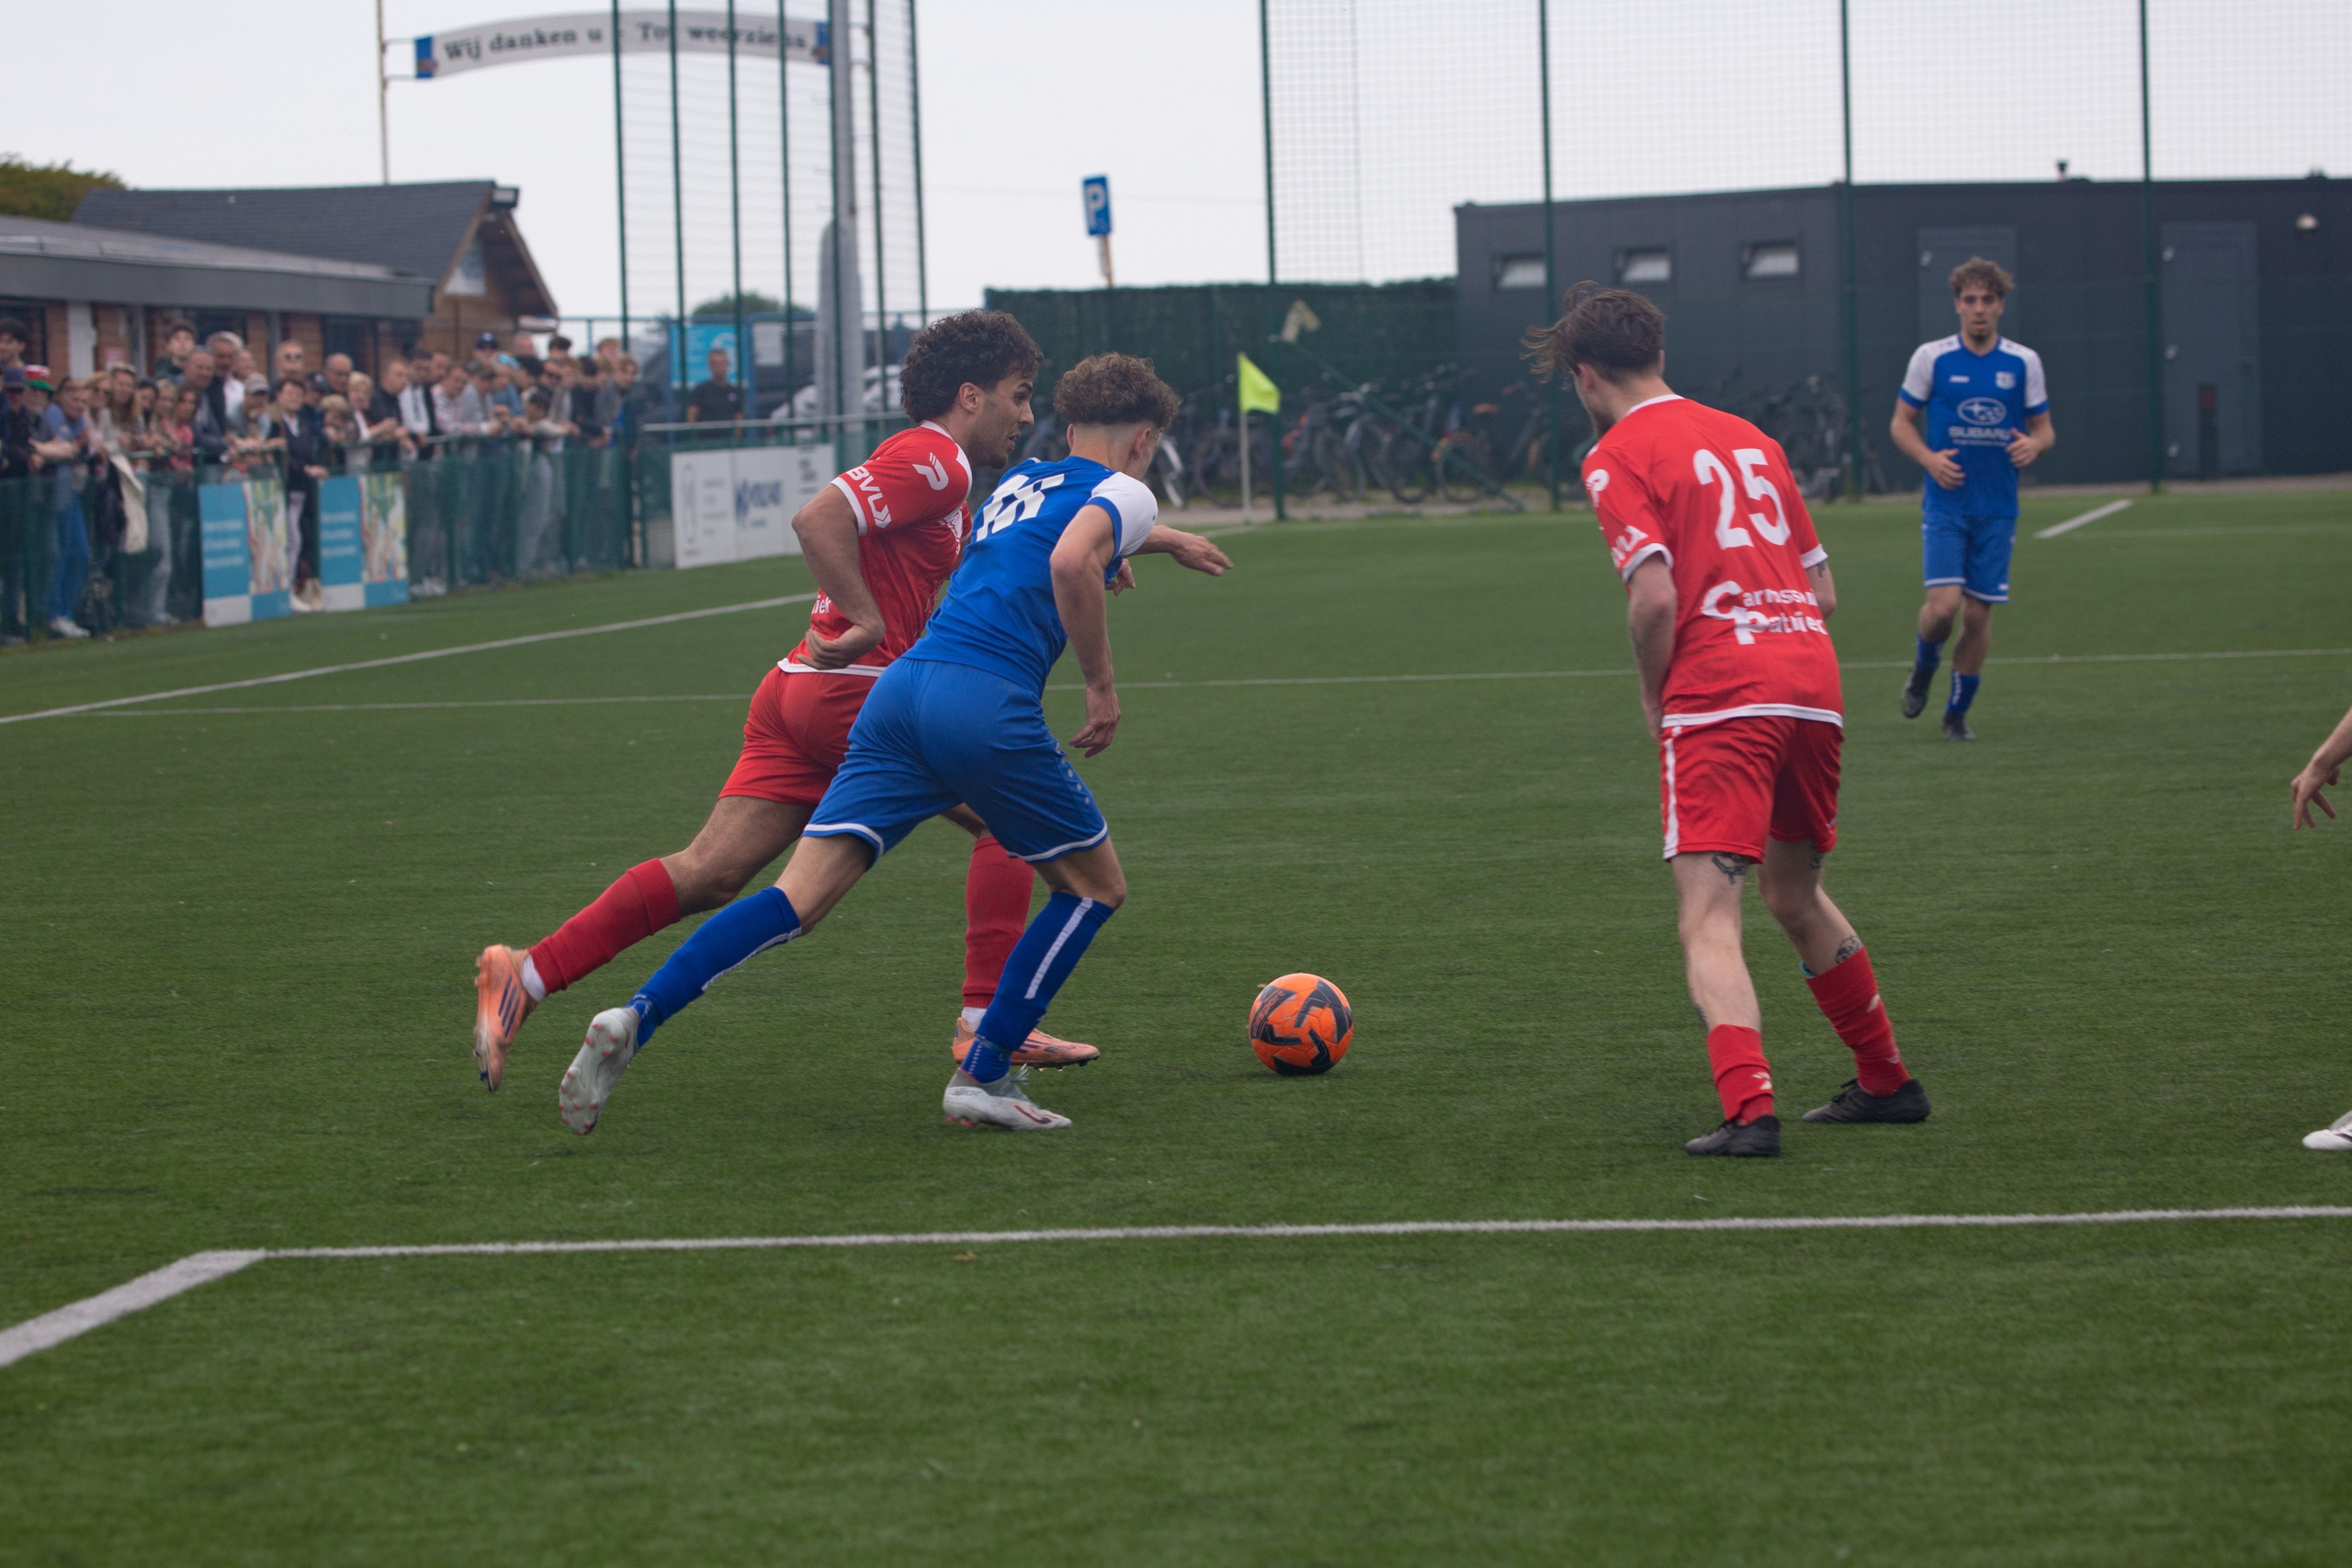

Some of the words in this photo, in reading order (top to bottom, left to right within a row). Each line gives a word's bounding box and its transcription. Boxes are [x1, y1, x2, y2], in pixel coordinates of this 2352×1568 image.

[445, 36, 481, 61] Wij
[489, 28, 578, 52] danken
[587, 28, 603, 42] u
[637, 20, 675, 42] To
[686, 25, 807, 48] weeziens
[1084, 182, 1106, 229] P
[1692, 448, 1792, 550] 25
